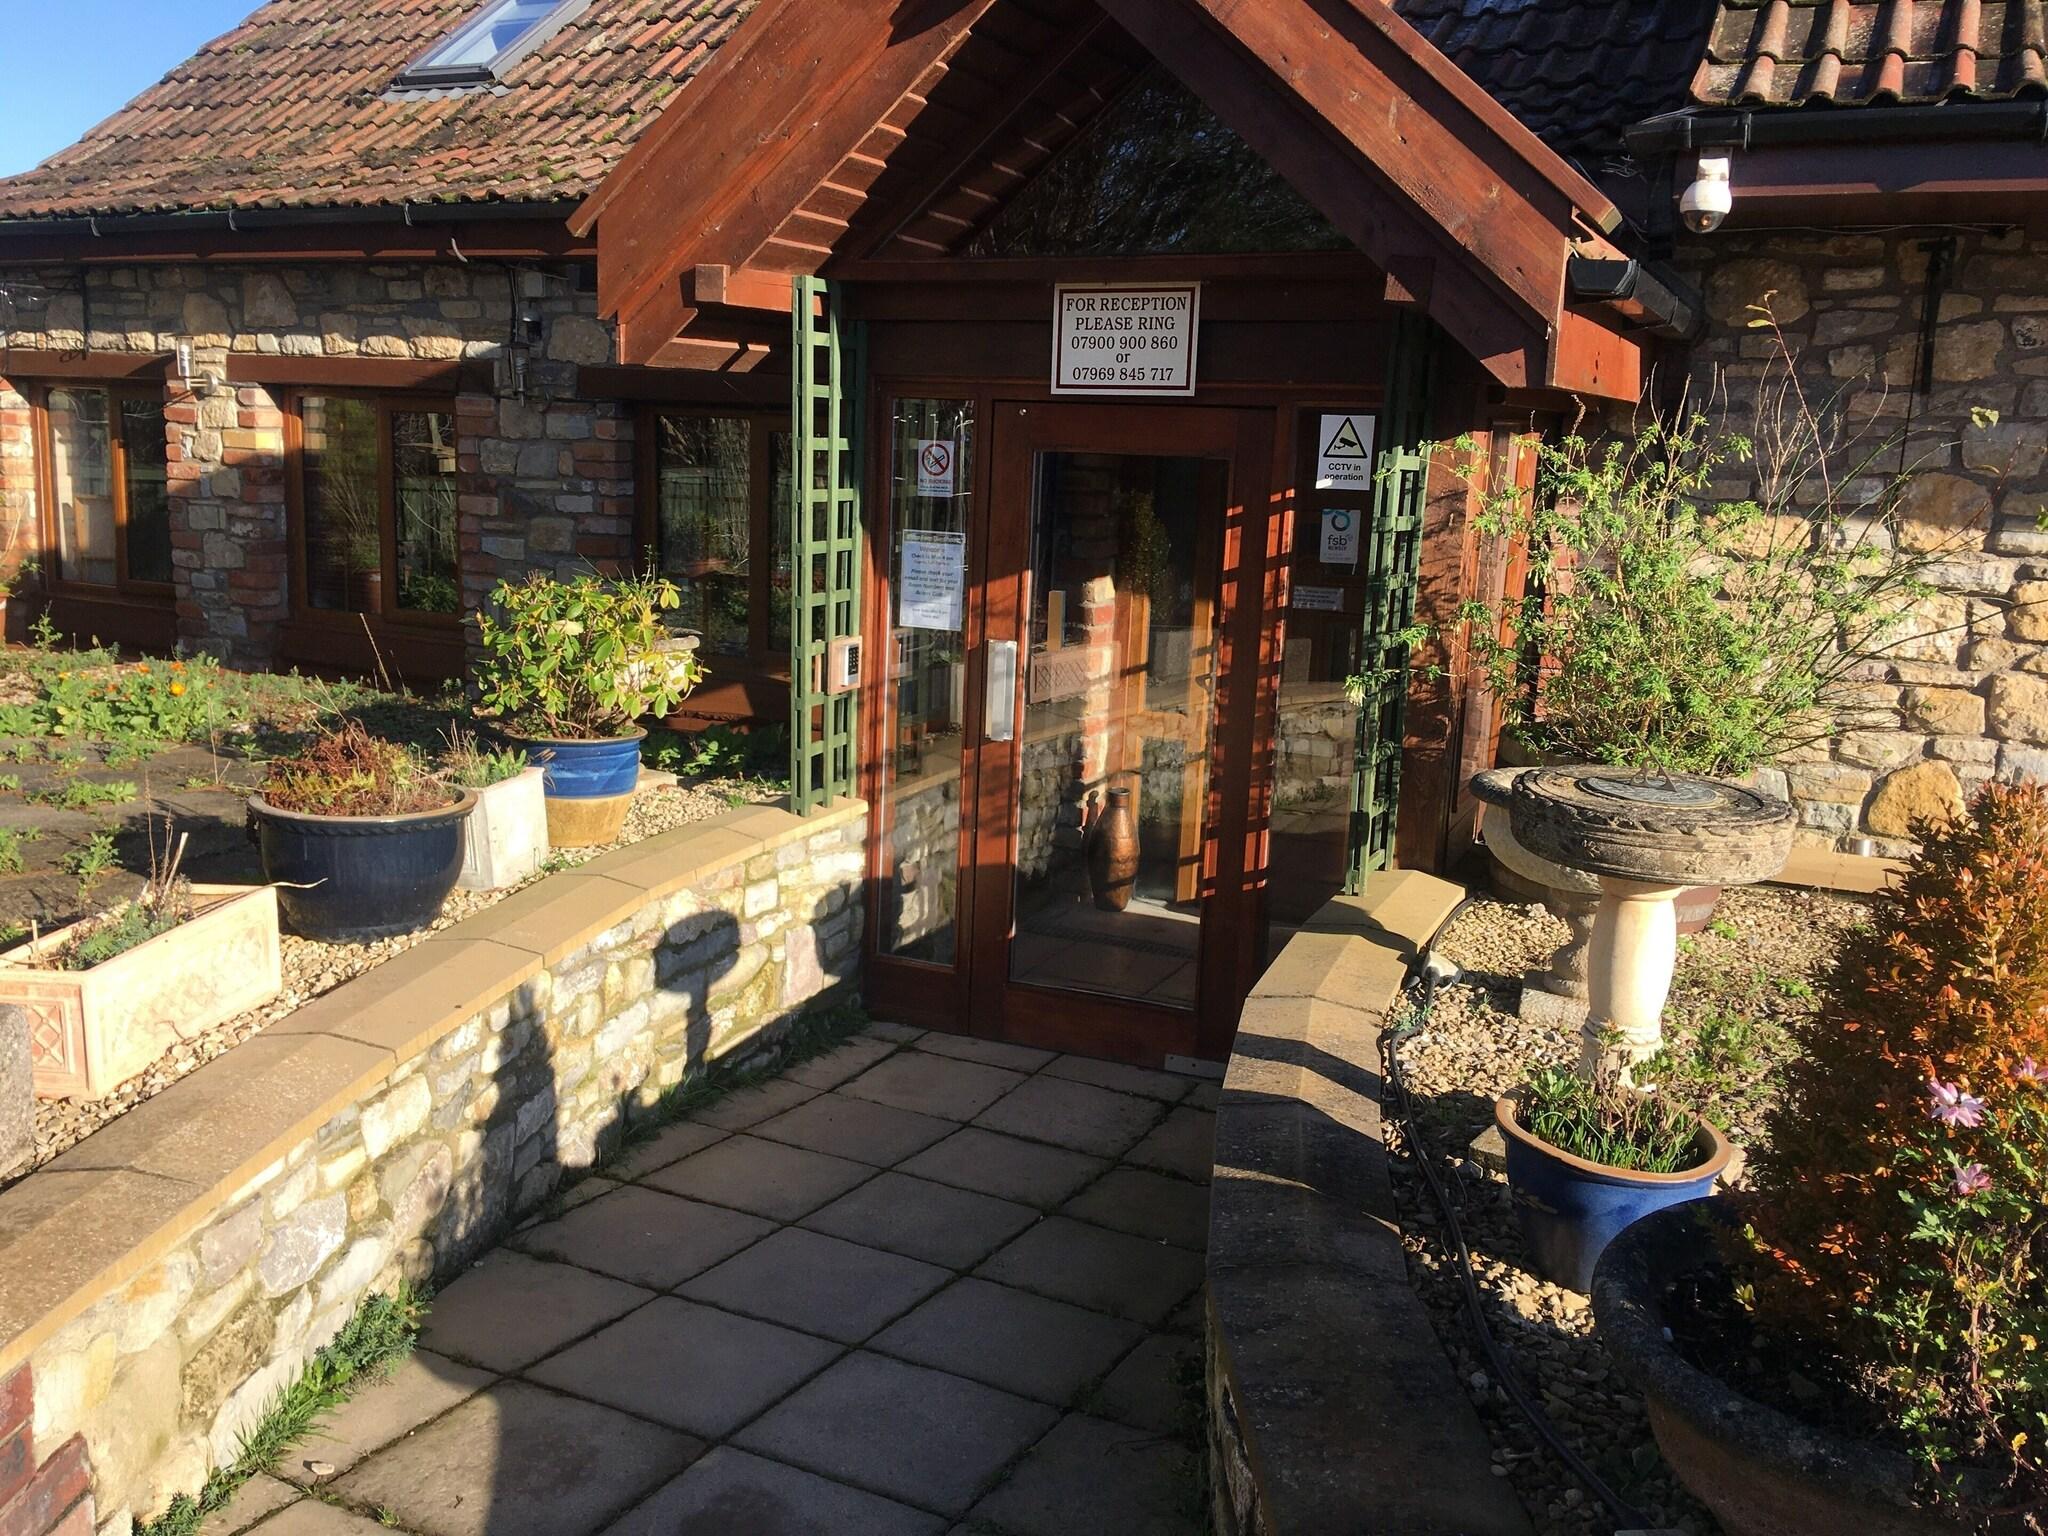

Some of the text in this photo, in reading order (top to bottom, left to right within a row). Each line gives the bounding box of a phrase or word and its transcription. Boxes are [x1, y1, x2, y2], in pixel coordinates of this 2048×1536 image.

[1066, 297, 1187, 311] FOR RECEPTION
[1075, 316, 1176, 330] PLEASE RING
[1071, 336, 1178, 349] 07900 900 860
[1116, 353, 1131, 363] or
[1072, 367, 1174, 380] 07969 845 717
[1328, 463, 1361, 471] CCTV in
[1328, 534, 1347, 545] fsb
